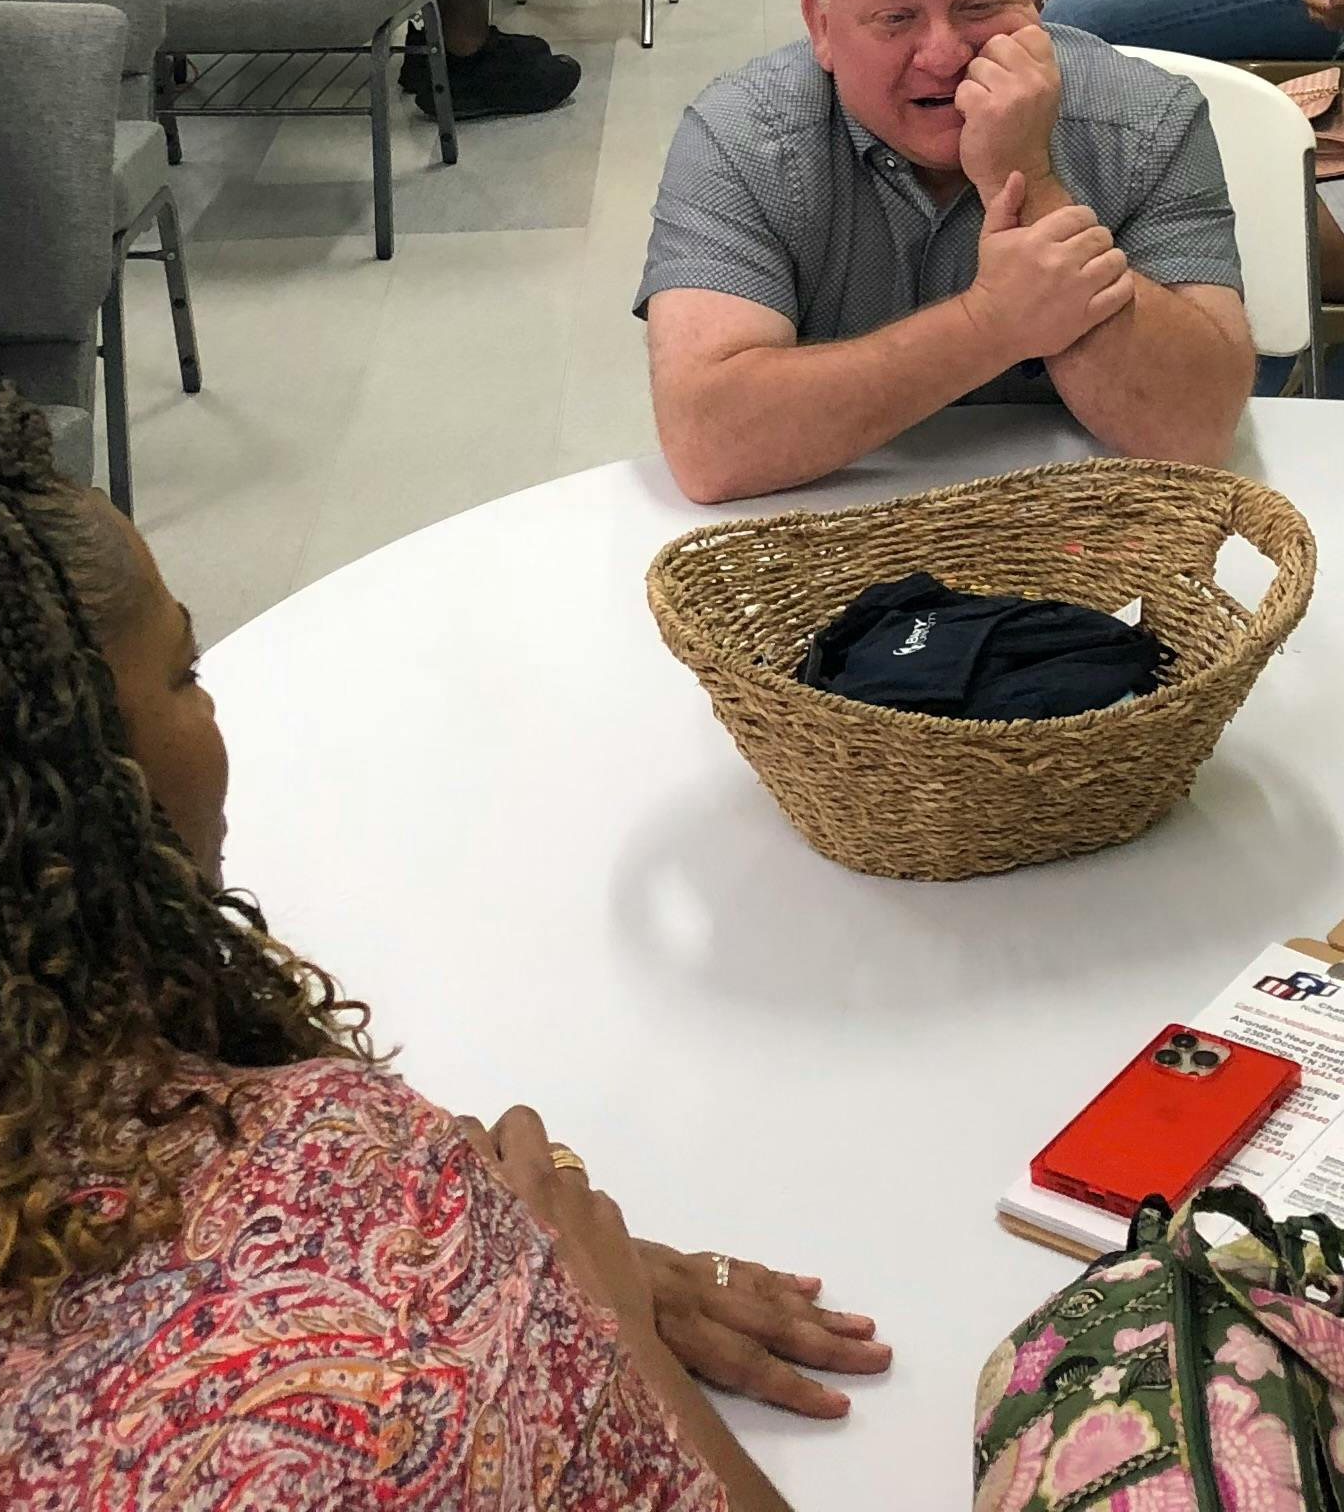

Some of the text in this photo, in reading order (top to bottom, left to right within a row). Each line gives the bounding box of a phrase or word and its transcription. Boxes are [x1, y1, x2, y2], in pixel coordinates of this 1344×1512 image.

[1229, 1014, 1284, 1035] Avondale
[1283, 1032, 1316, 1046] Head
[1242, 1027, 1271, 1040] 2302
[1271, 1037, 1311, 1053] Ocoee
[1299, 1055, 1318, 1065] TN
